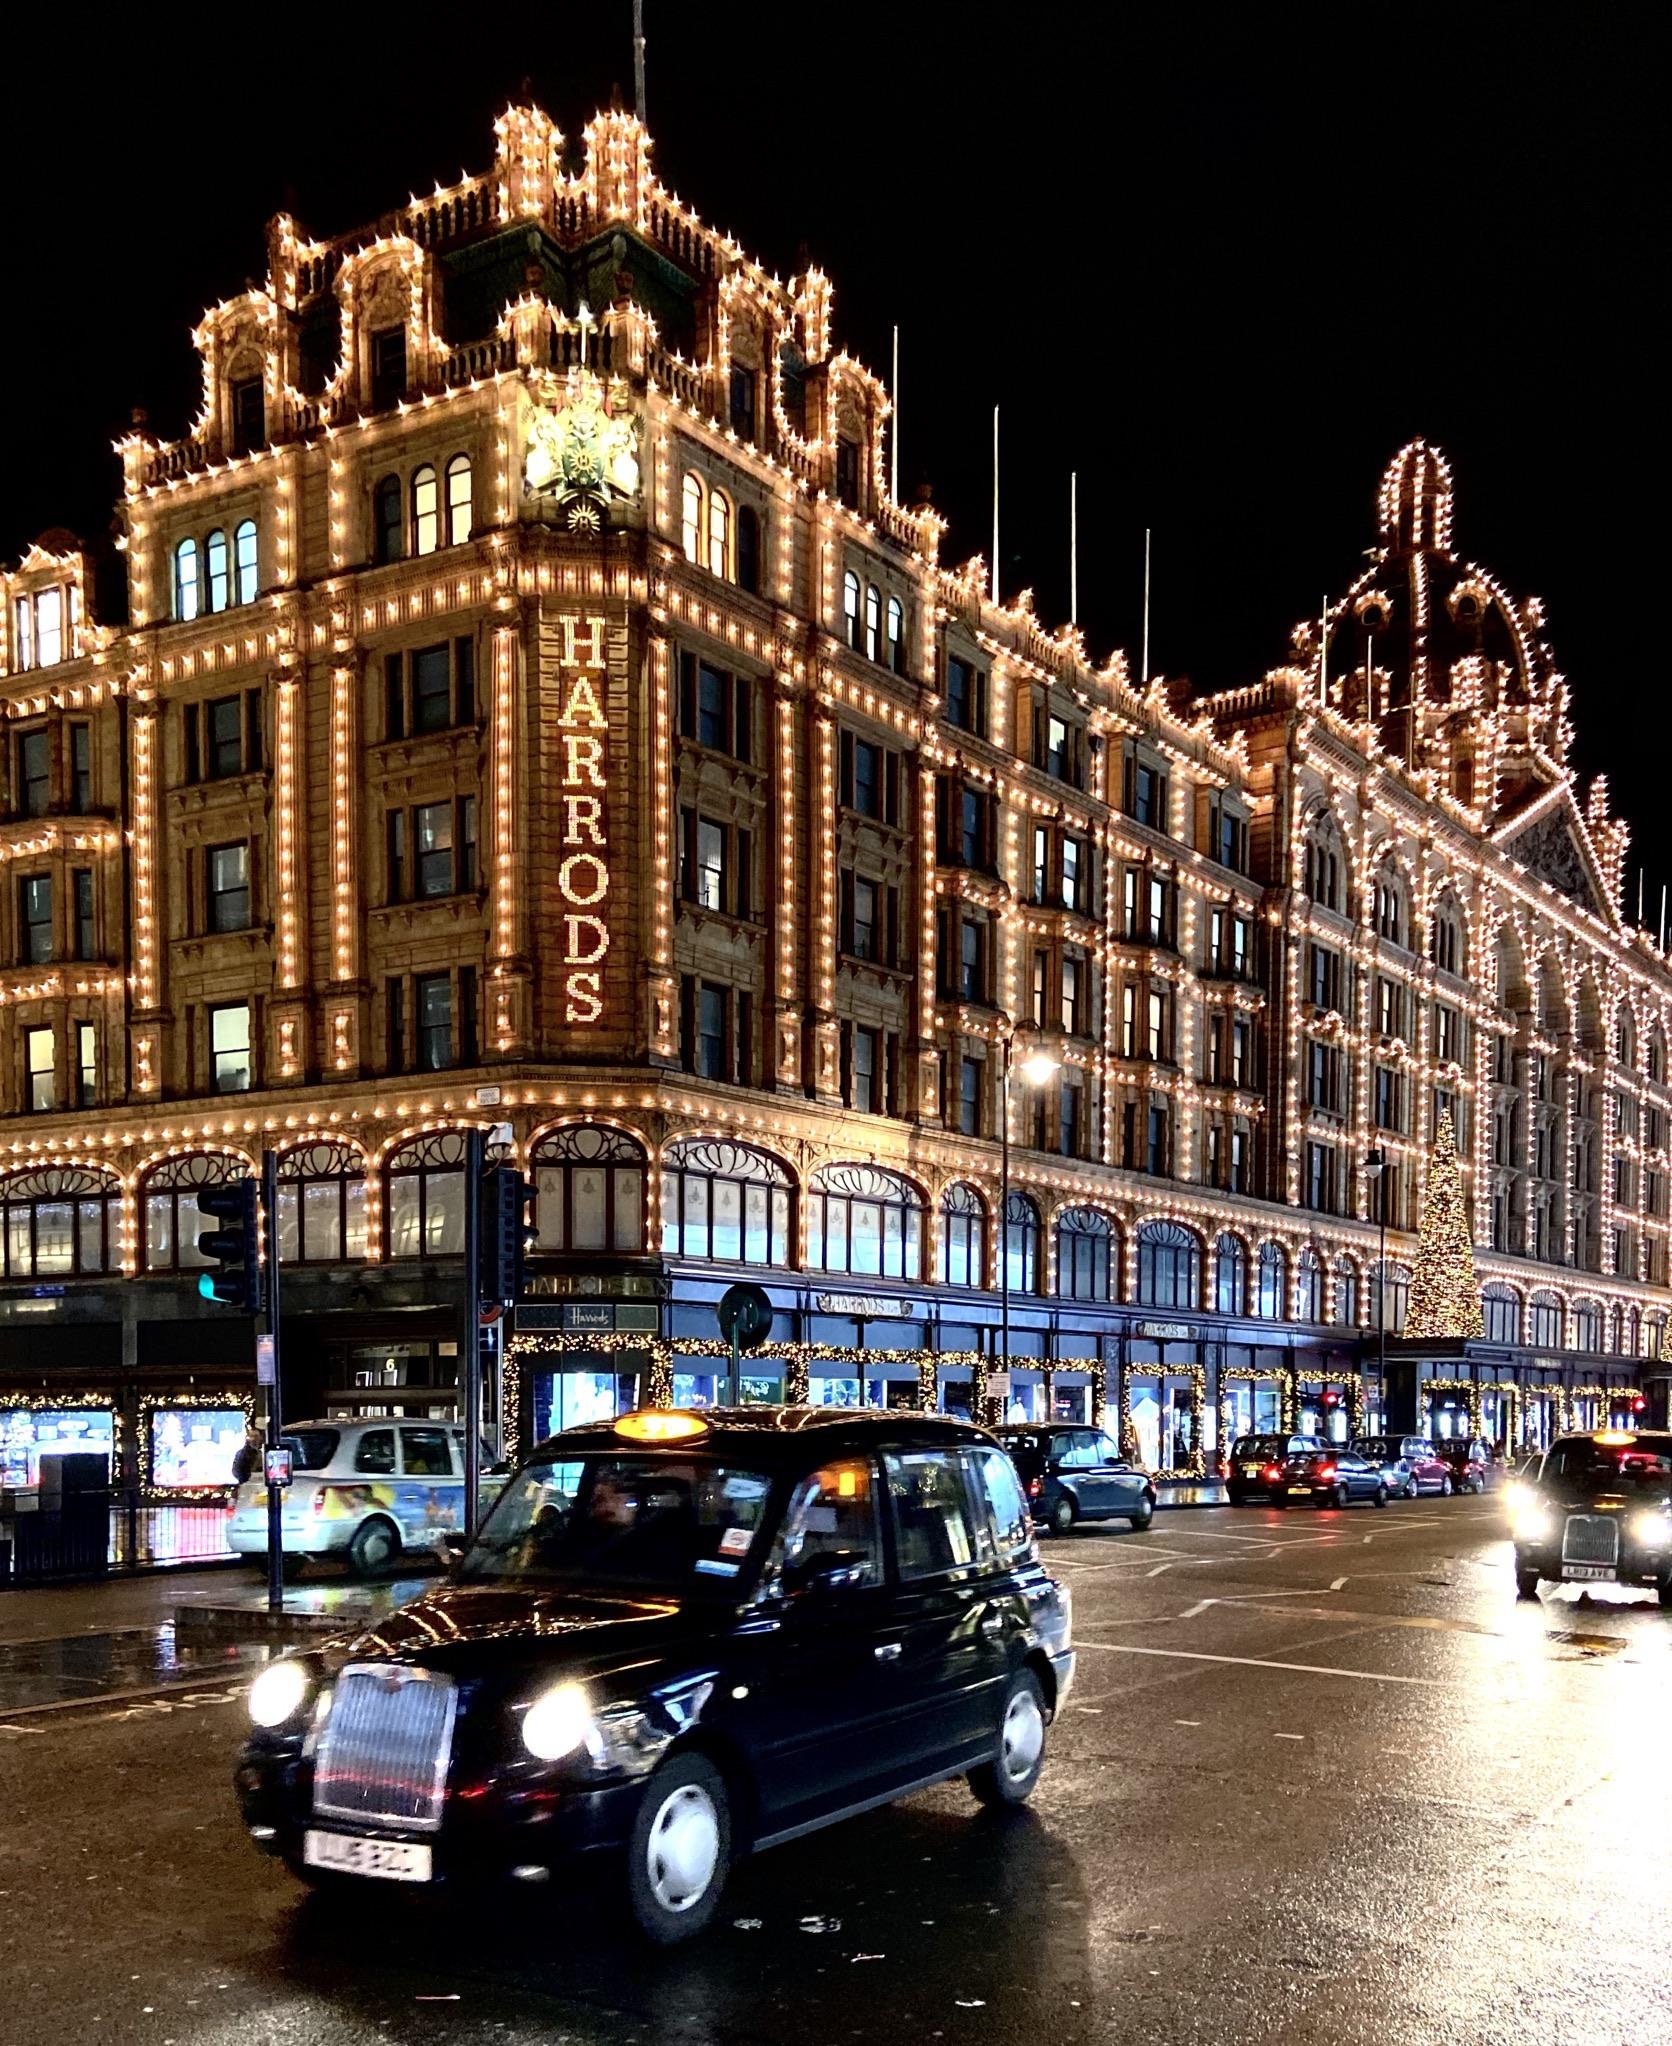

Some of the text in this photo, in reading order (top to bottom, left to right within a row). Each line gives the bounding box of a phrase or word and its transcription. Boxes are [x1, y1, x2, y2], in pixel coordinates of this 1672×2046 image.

[558, 615, 609, 1022] HARRODS
[569, 1307, 609, 1325] Harrods
[386, 1359, 395, 1370] 6
